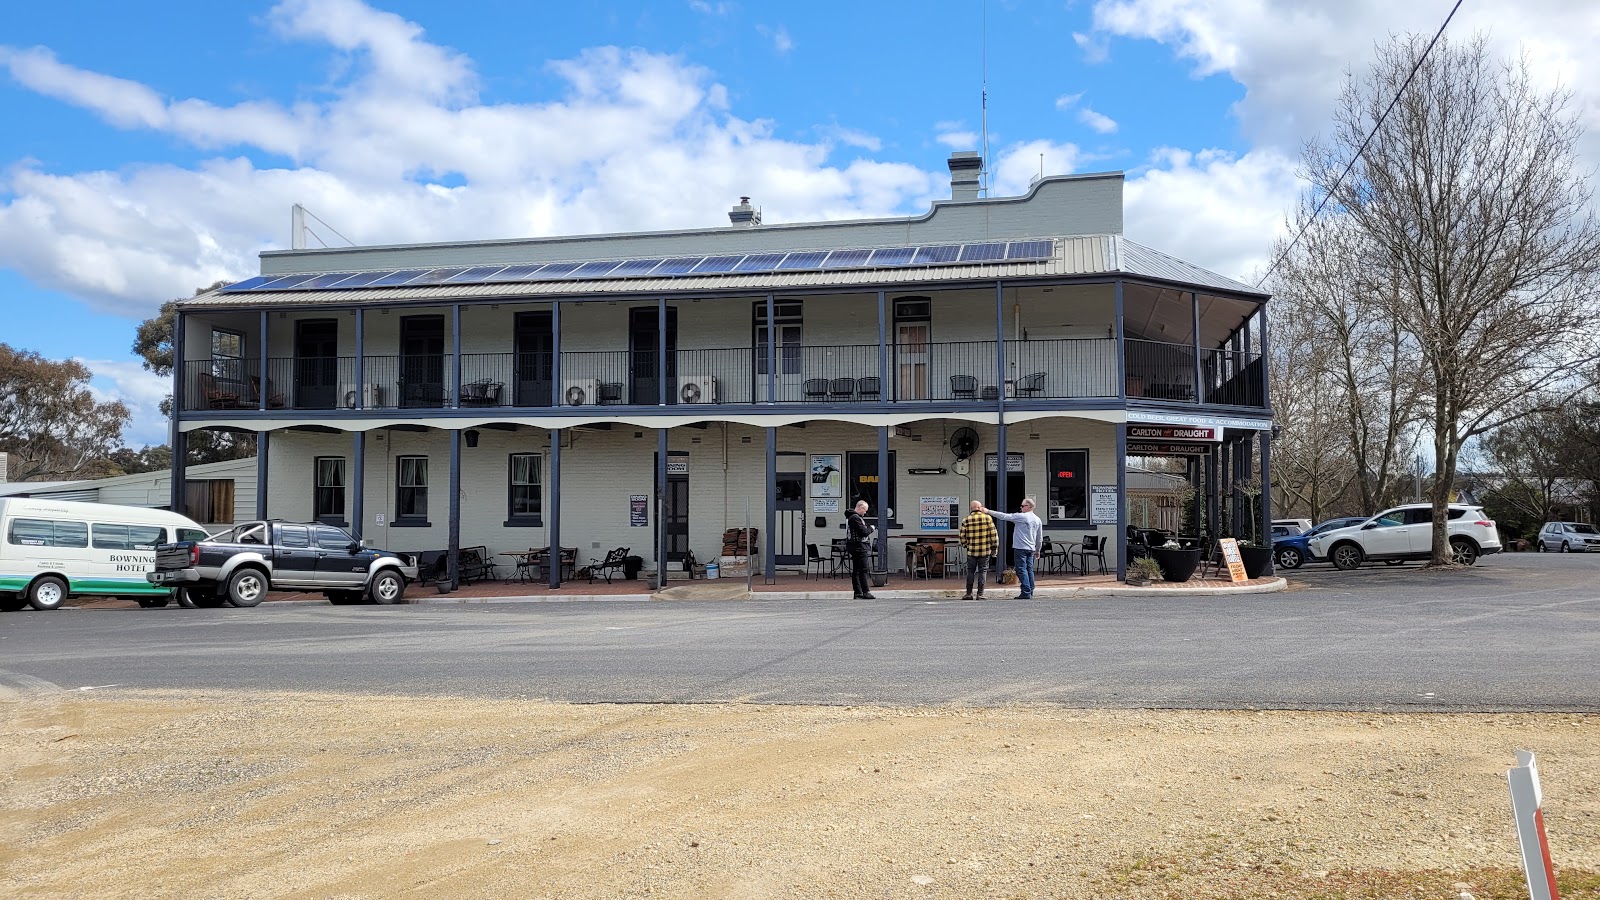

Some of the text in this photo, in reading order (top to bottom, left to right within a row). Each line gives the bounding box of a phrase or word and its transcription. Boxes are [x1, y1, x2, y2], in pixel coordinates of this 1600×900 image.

[1167, 415, 1188, 423] GREAT
[1216, 419, 1268, 428] ACCOMMODATION
[1131, 428, 1162, 436] CARLTON
[1173, 429, 1210, 438] DRAUGHT
[1127, 443, 1158, 451] CARLTON
[1170, 445, 1204, 453] DRAUGHT
[110, 554, 155, 563] BOWNING
[116, 564, 147, 572] HOTEL
